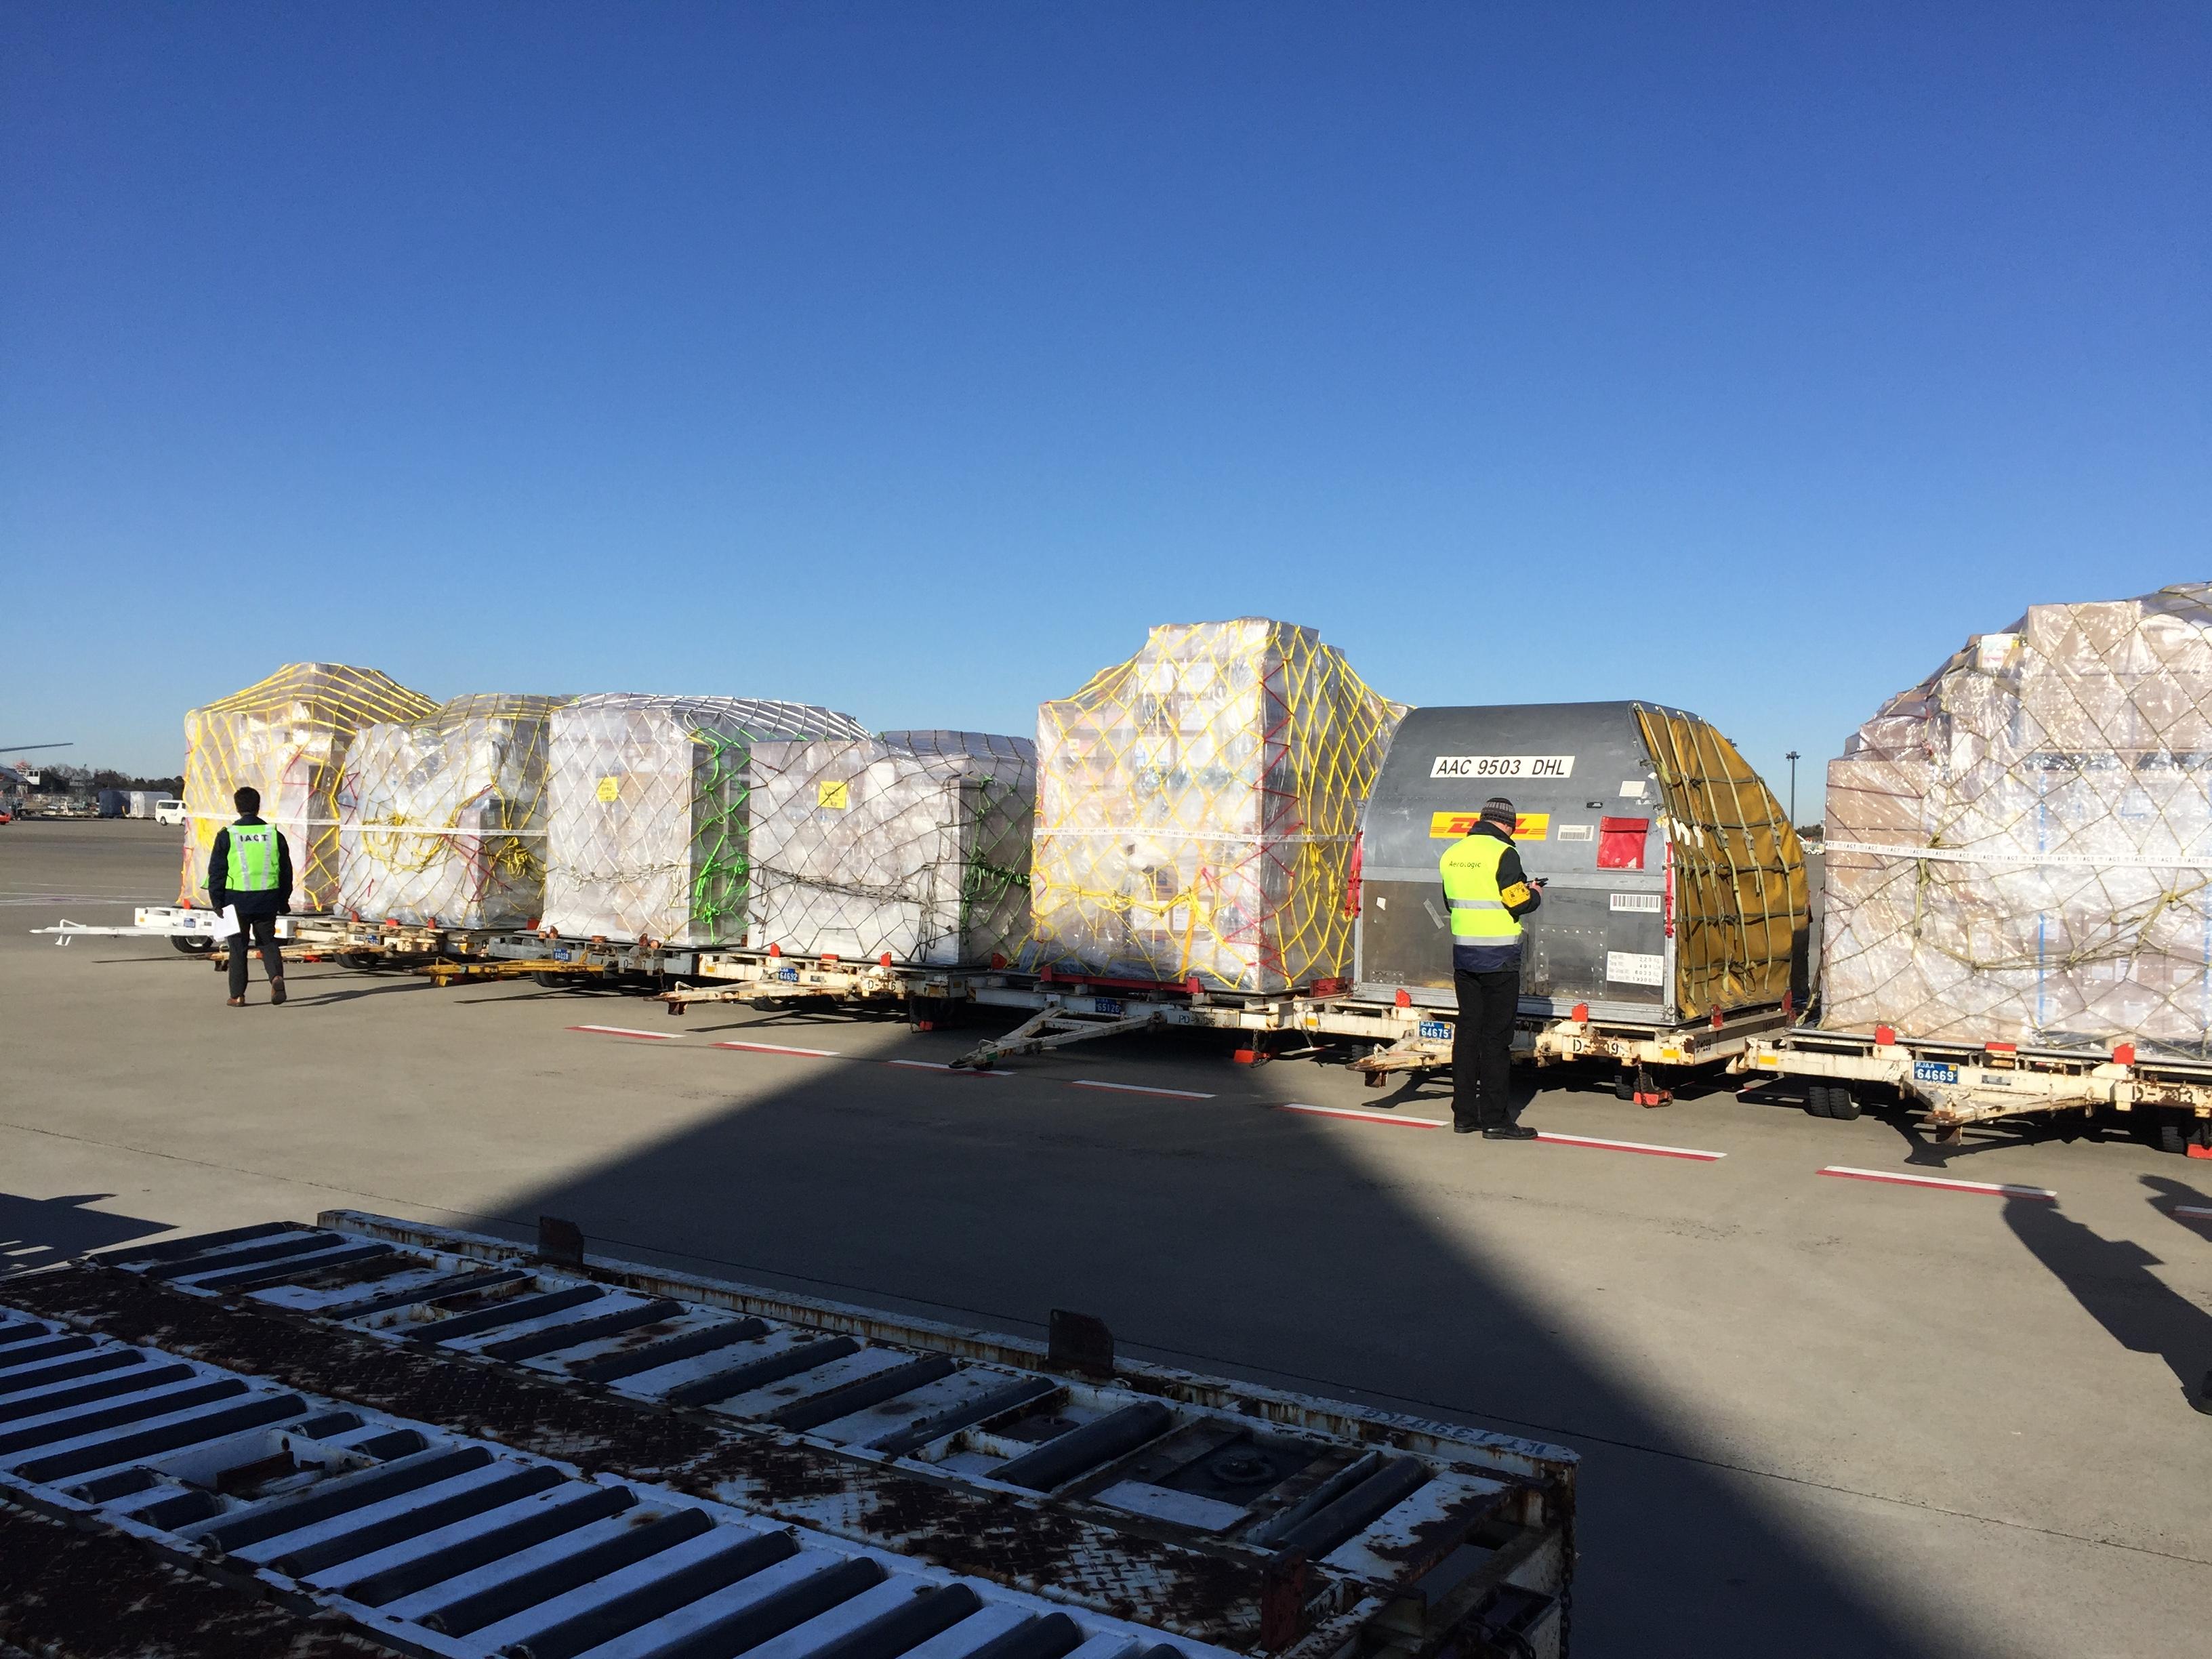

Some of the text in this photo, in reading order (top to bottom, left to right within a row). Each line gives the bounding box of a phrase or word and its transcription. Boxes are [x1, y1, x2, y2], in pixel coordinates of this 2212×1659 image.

[1436, 759, 1565, 775] AAC 9503 DHL
[1447, 817, 1530, 834] DL
[1421, 1027, 1449, 1038] 64675
[1917, 1069, 1954, 1082] 64669
